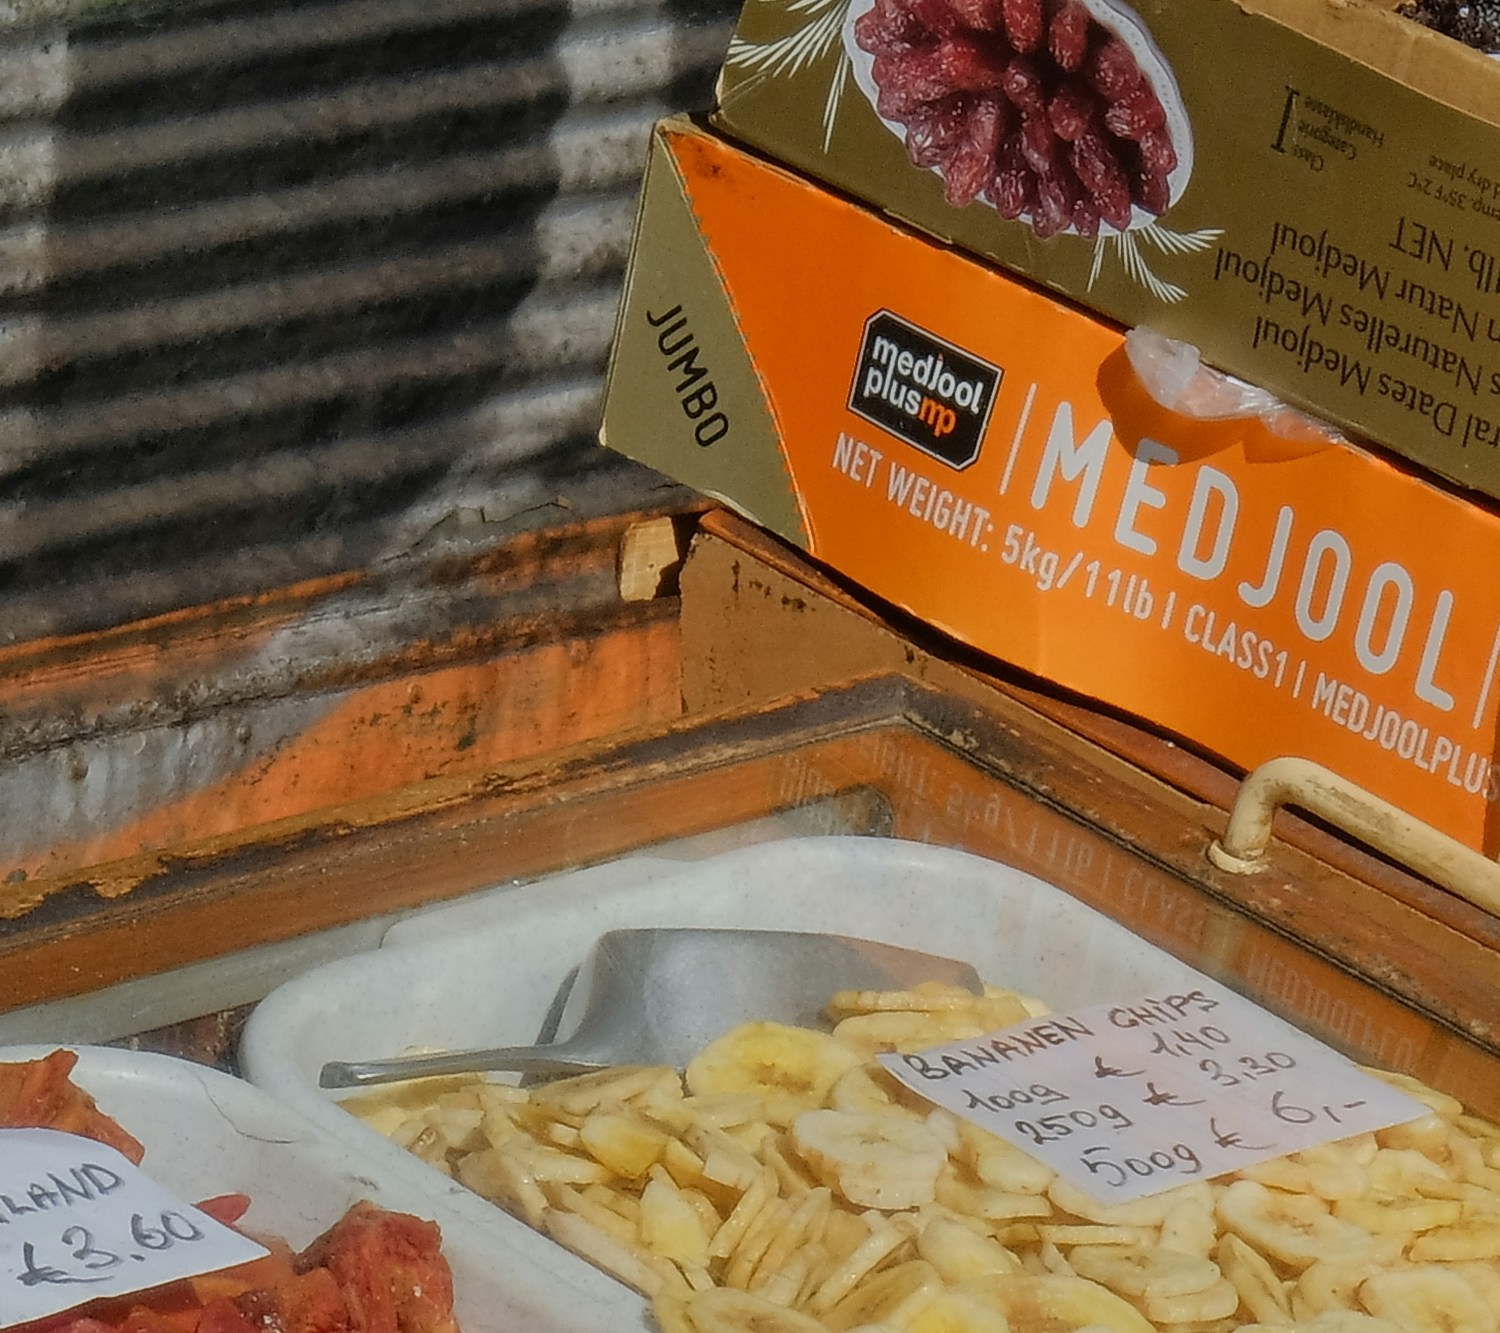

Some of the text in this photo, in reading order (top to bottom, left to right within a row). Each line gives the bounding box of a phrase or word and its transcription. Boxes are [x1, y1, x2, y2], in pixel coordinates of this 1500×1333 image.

[1270, 220, 1390, 301] Medjoul
[1389, 214, 1454, 271] NET
[1213, 246, 1334, 326] Medjoul
[1395, 280, 1477, 342] Natur
[646, 304, 730, 448] JUMBO
[870, 334, 985, 416] medjool
[1252, 314, 1372, 395] Medjoul
[1339, 302, 1483, 395] Naturelles
[1377, 372, 1458, 437] Dates
[831, 431, 884, 488] NET
[887, 458, 995, 552] WEIGHT:
[1029, 400, 1456, 713] MEDJOOL
[901, 1015, 1097, 1084] BANANEN
[965, 1081, 1072, 1115] 100g
[1094, 1054, 1147, 1080] €
[1014, 1103, 1136, 1148] 250g
[1141, 1080, 1207, 1108] €
[1081, 1143, 1203, 1188] 500g
[1209, 1117, 1278, 1152] €
